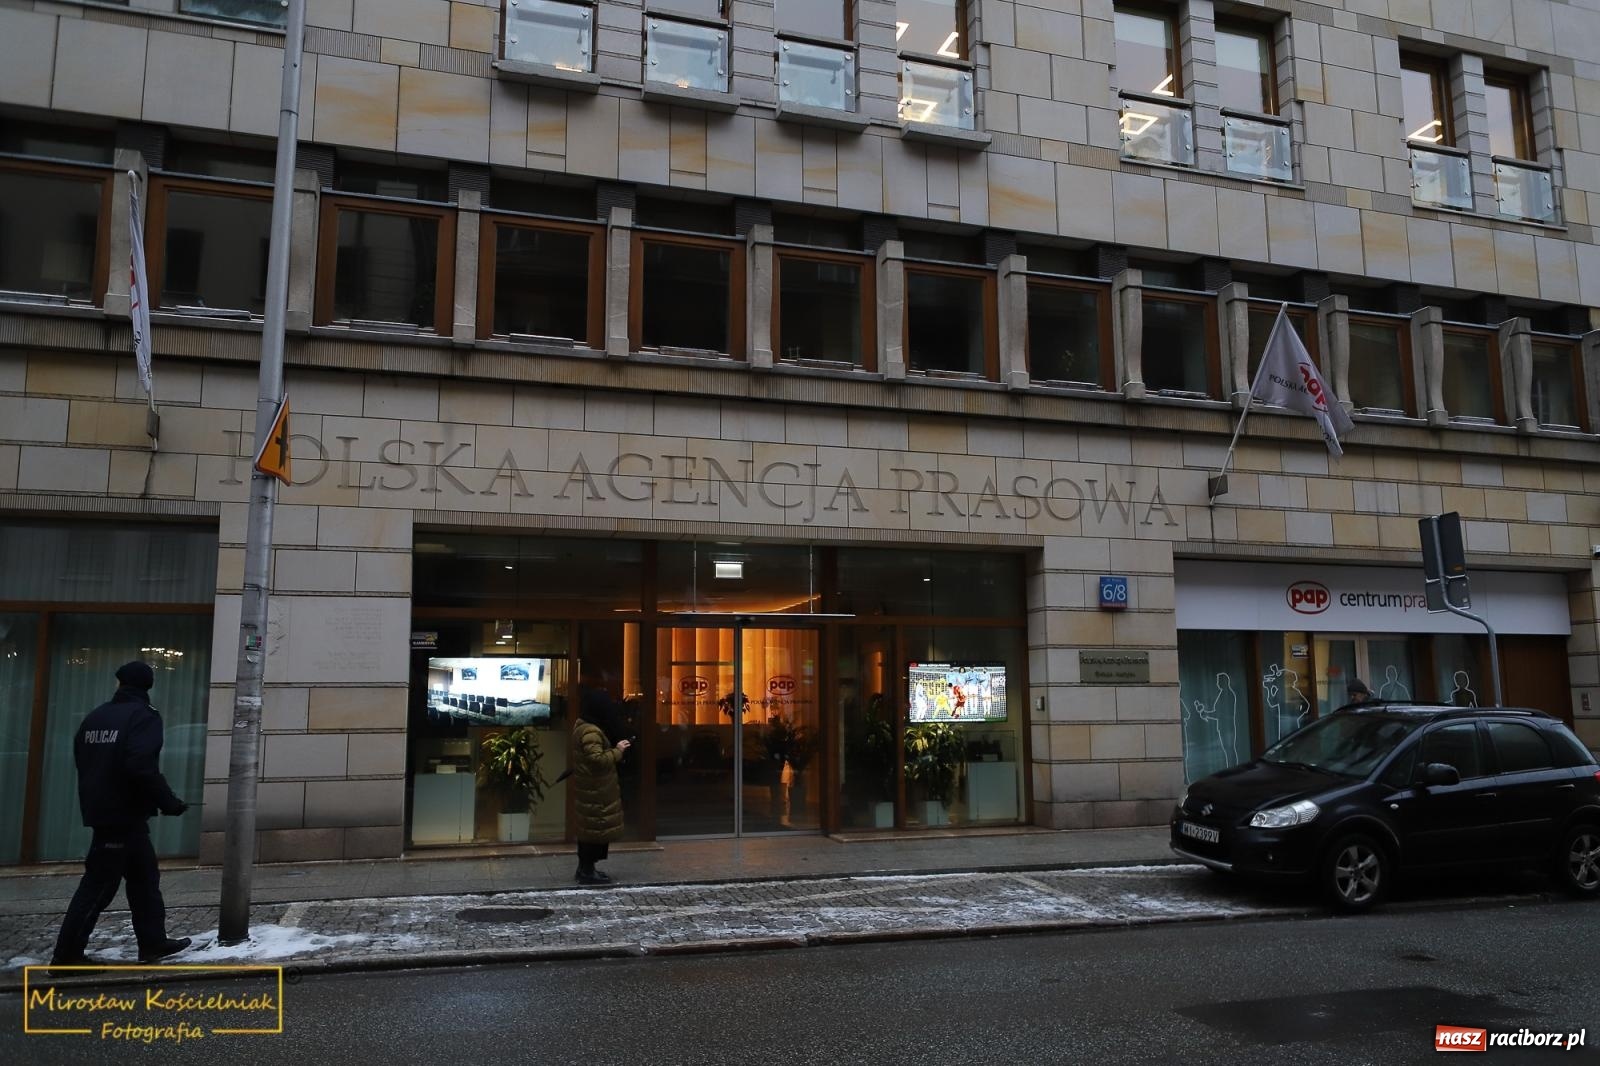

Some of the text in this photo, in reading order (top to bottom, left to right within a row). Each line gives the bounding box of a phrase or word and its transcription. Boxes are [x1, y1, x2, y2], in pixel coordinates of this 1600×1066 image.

[218, 429, 1180, 527] POLSKA AGENCJA PRASOWA
[1103, 584, 1126, 602] 6/8
[1291, 588, 1427, 612] pap centrumpra
[681, 681, 708, 692] pap
[769, 681, 795, 692] pap
[84, 729, 119, 744] POLICJA
